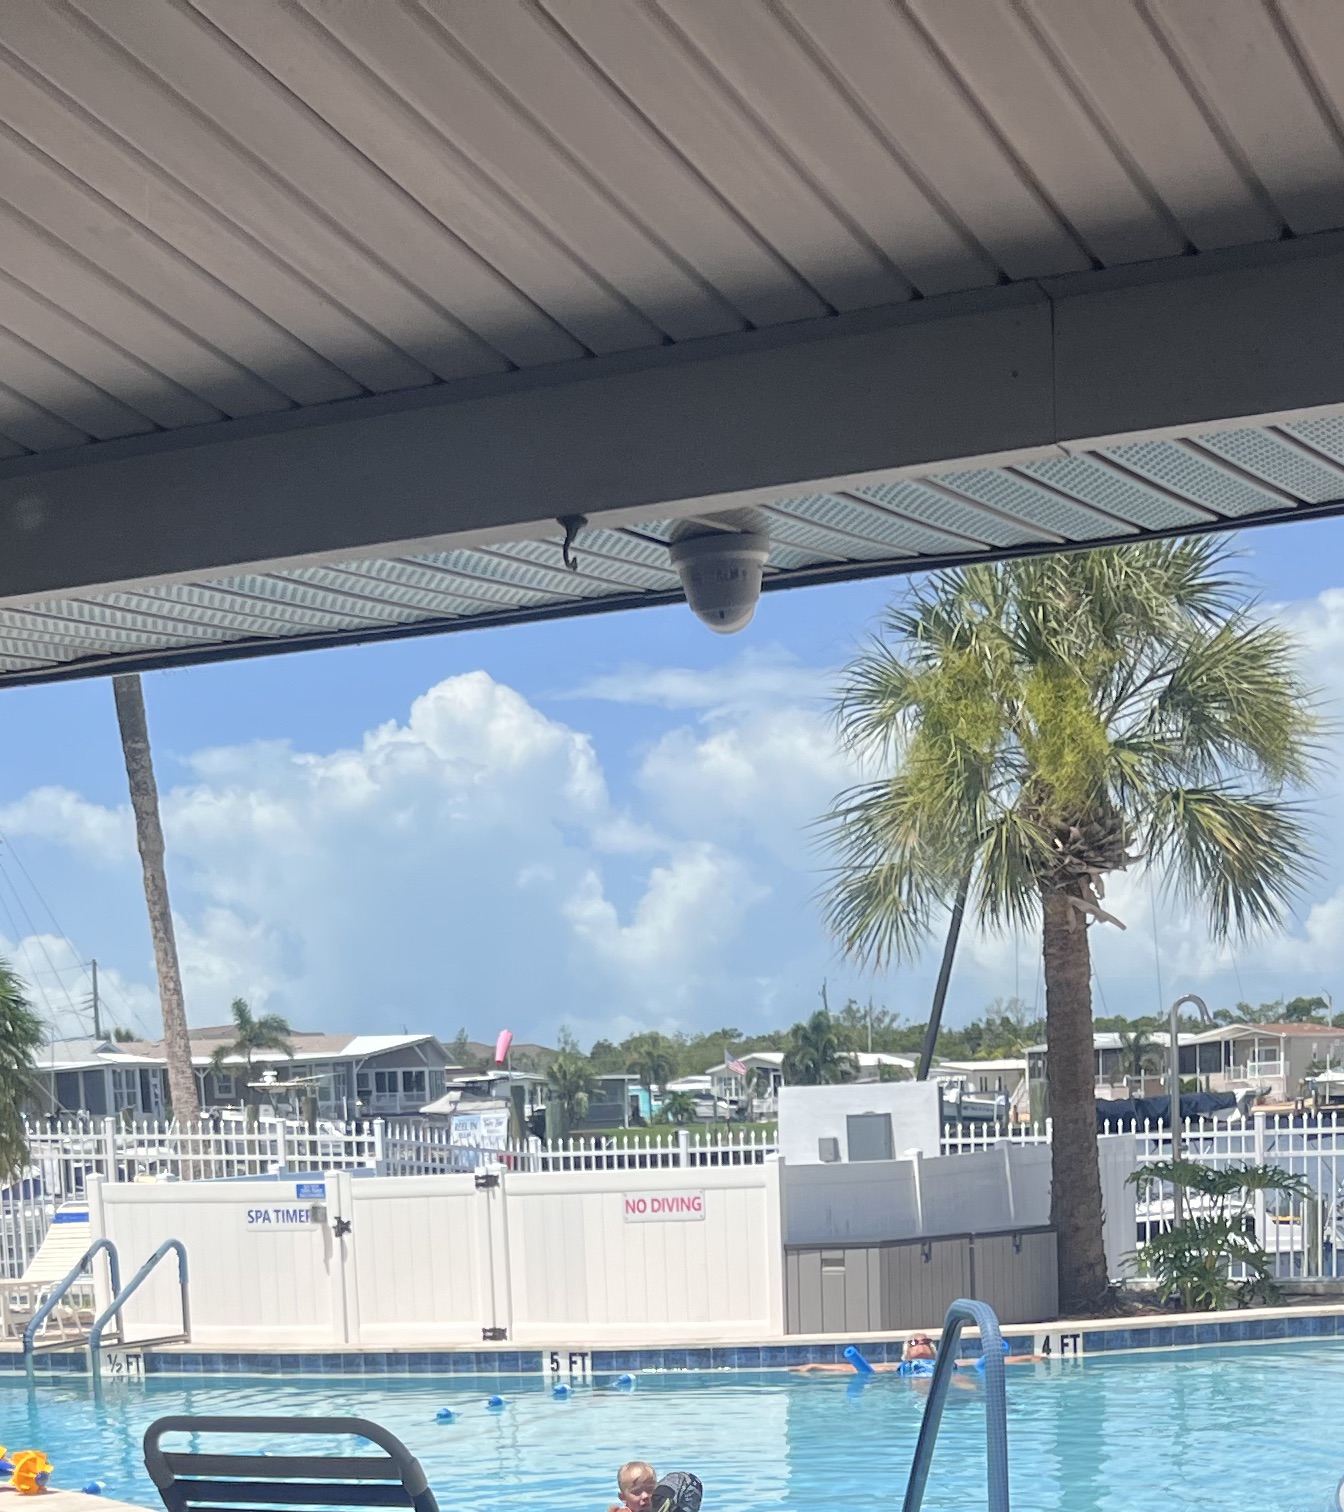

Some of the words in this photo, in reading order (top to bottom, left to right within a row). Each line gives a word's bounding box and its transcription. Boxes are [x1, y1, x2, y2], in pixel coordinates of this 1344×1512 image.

[625, 1198, 647, 1214] NO
[651, 1196, 702, 1213] DIVING
[247, 1209, 272, 1224] SPA
[1042, 1335, 1052, 1355] 4
[1060, 1333, 1080, 1354] FT
[126, 1354, 142, 1375] FT
[550, 1351, 560, 1372] 5
[568, 1352, 589, 1372] FT
